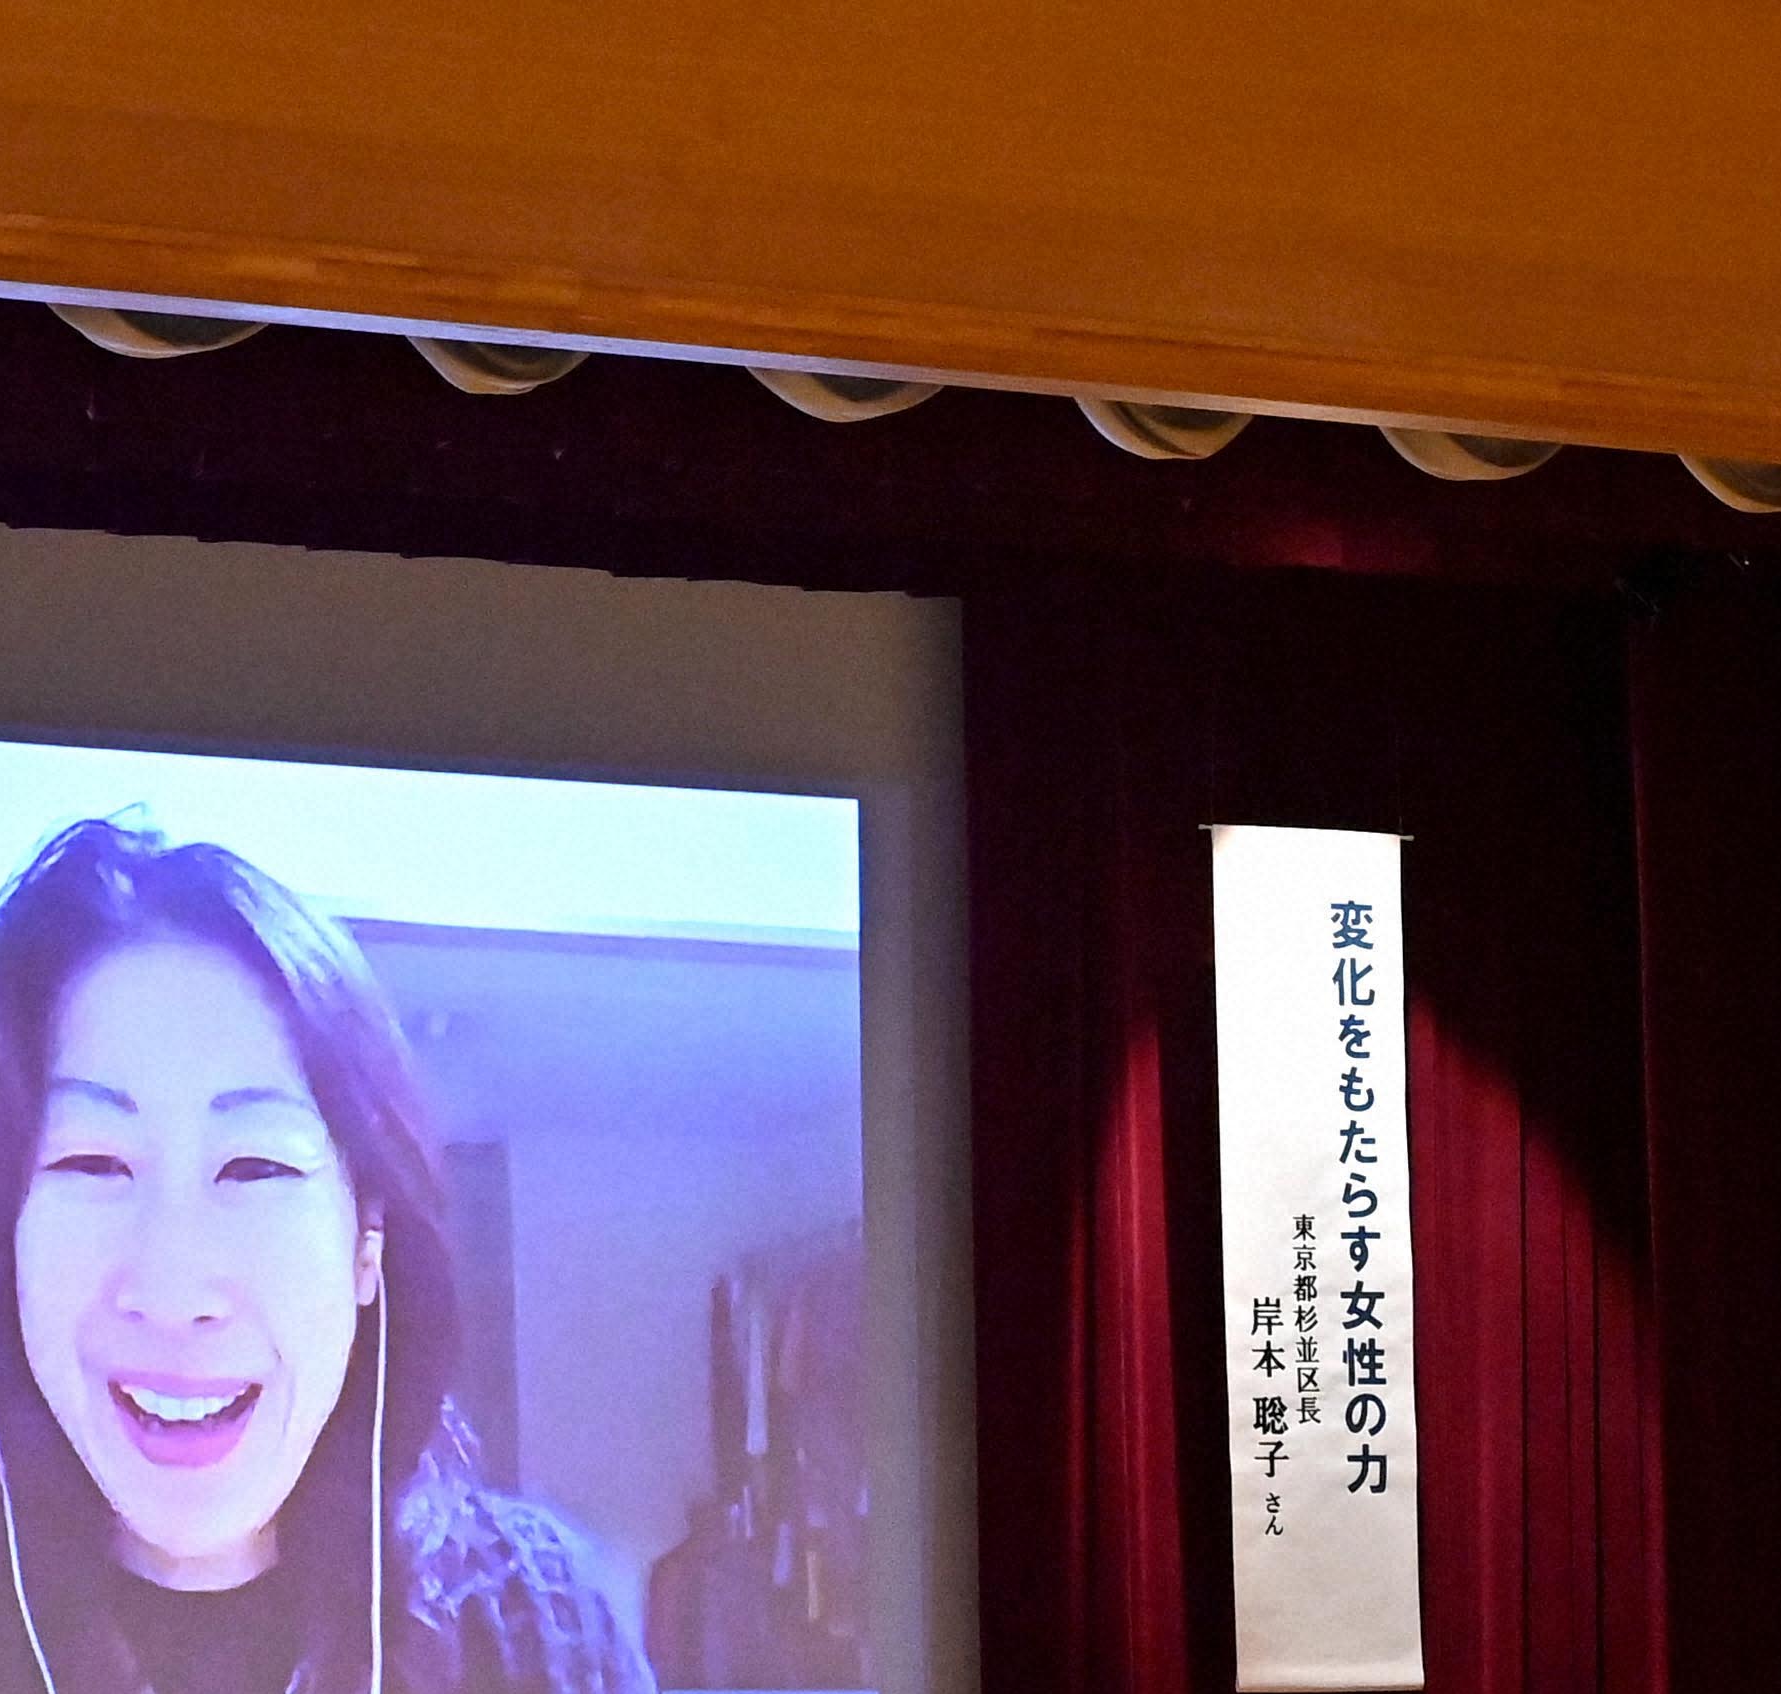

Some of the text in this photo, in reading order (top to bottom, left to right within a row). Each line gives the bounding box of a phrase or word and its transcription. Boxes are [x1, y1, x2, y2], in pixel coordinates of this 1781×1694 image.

[1292, 1213, 1321, 1425] 東京都杉並区長
[1331, 900, 1388, 1494] 変化をもたらす女性の力
